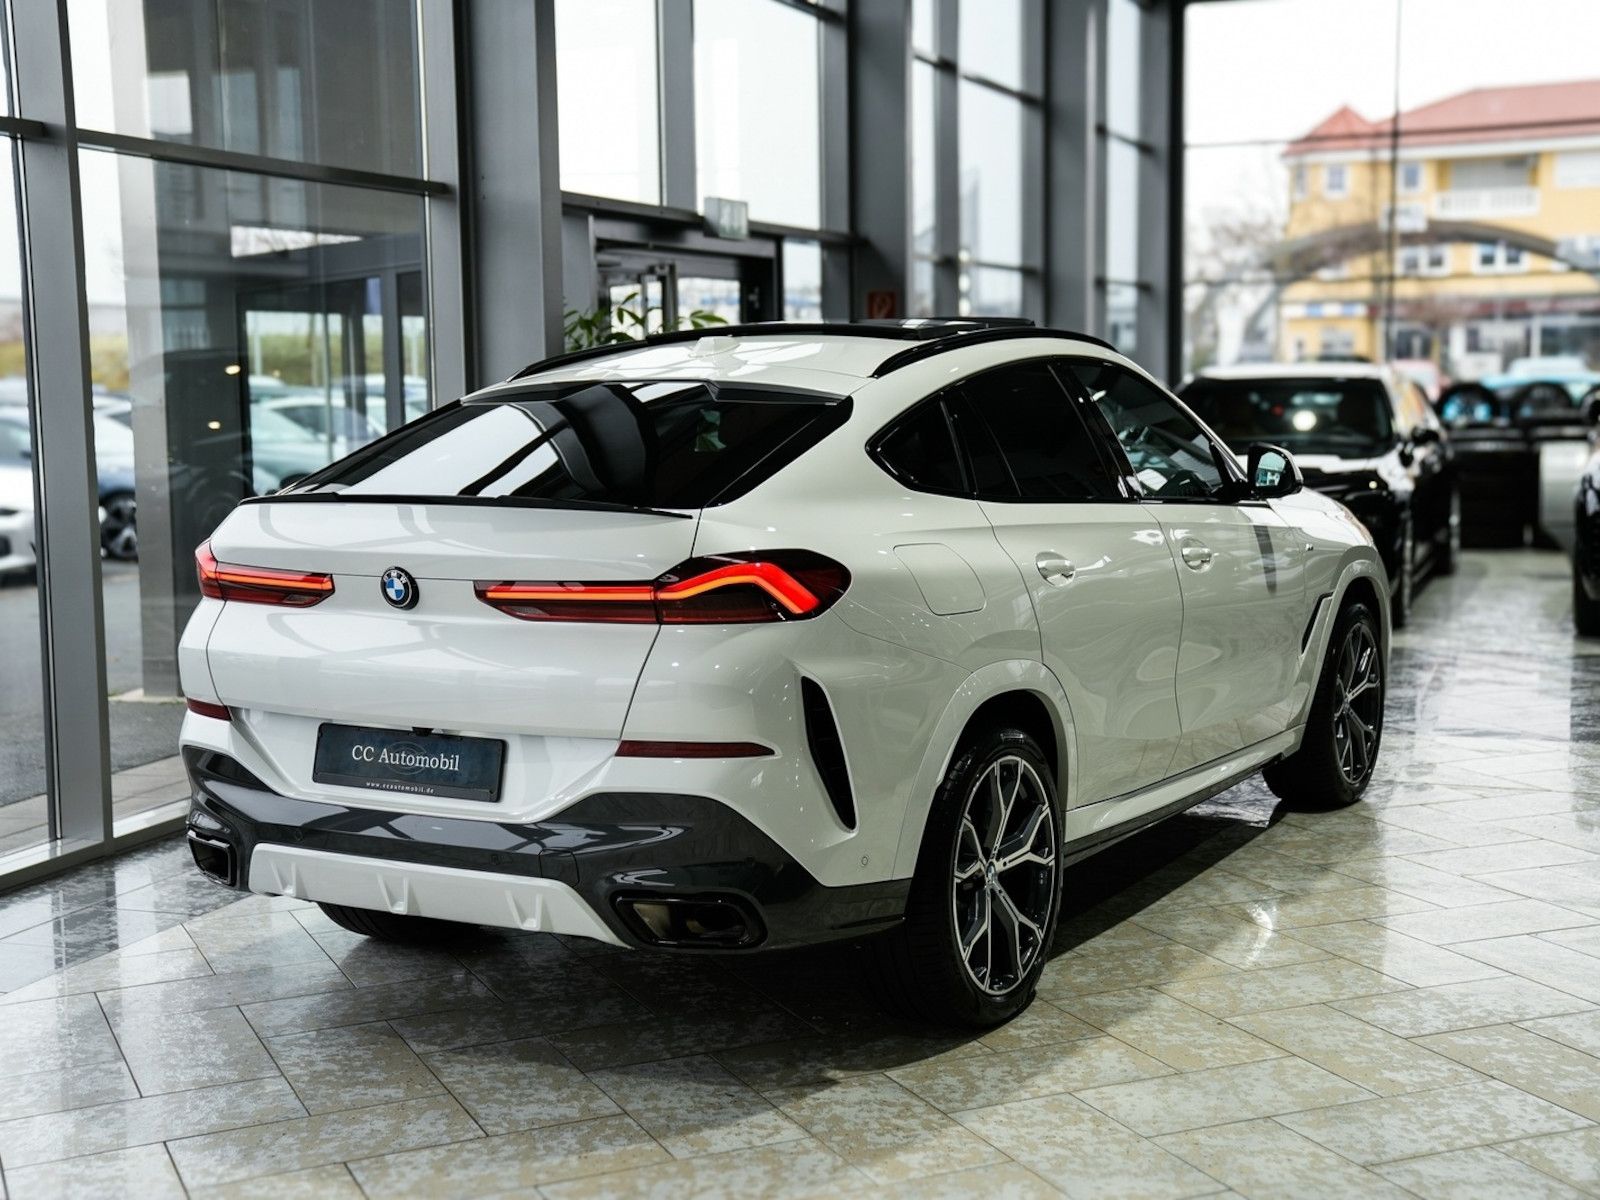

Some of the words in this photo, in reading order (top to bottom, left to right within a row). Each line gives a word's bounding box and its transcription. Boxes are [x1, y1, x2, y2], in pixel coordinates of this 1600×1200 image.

[383, 570, 407, 584] BMW
[352, 745, 374, 761] CC
[379, 748, 459, 771] Automobil
[366, 782, 434, 794] www.ccautomobil.de
